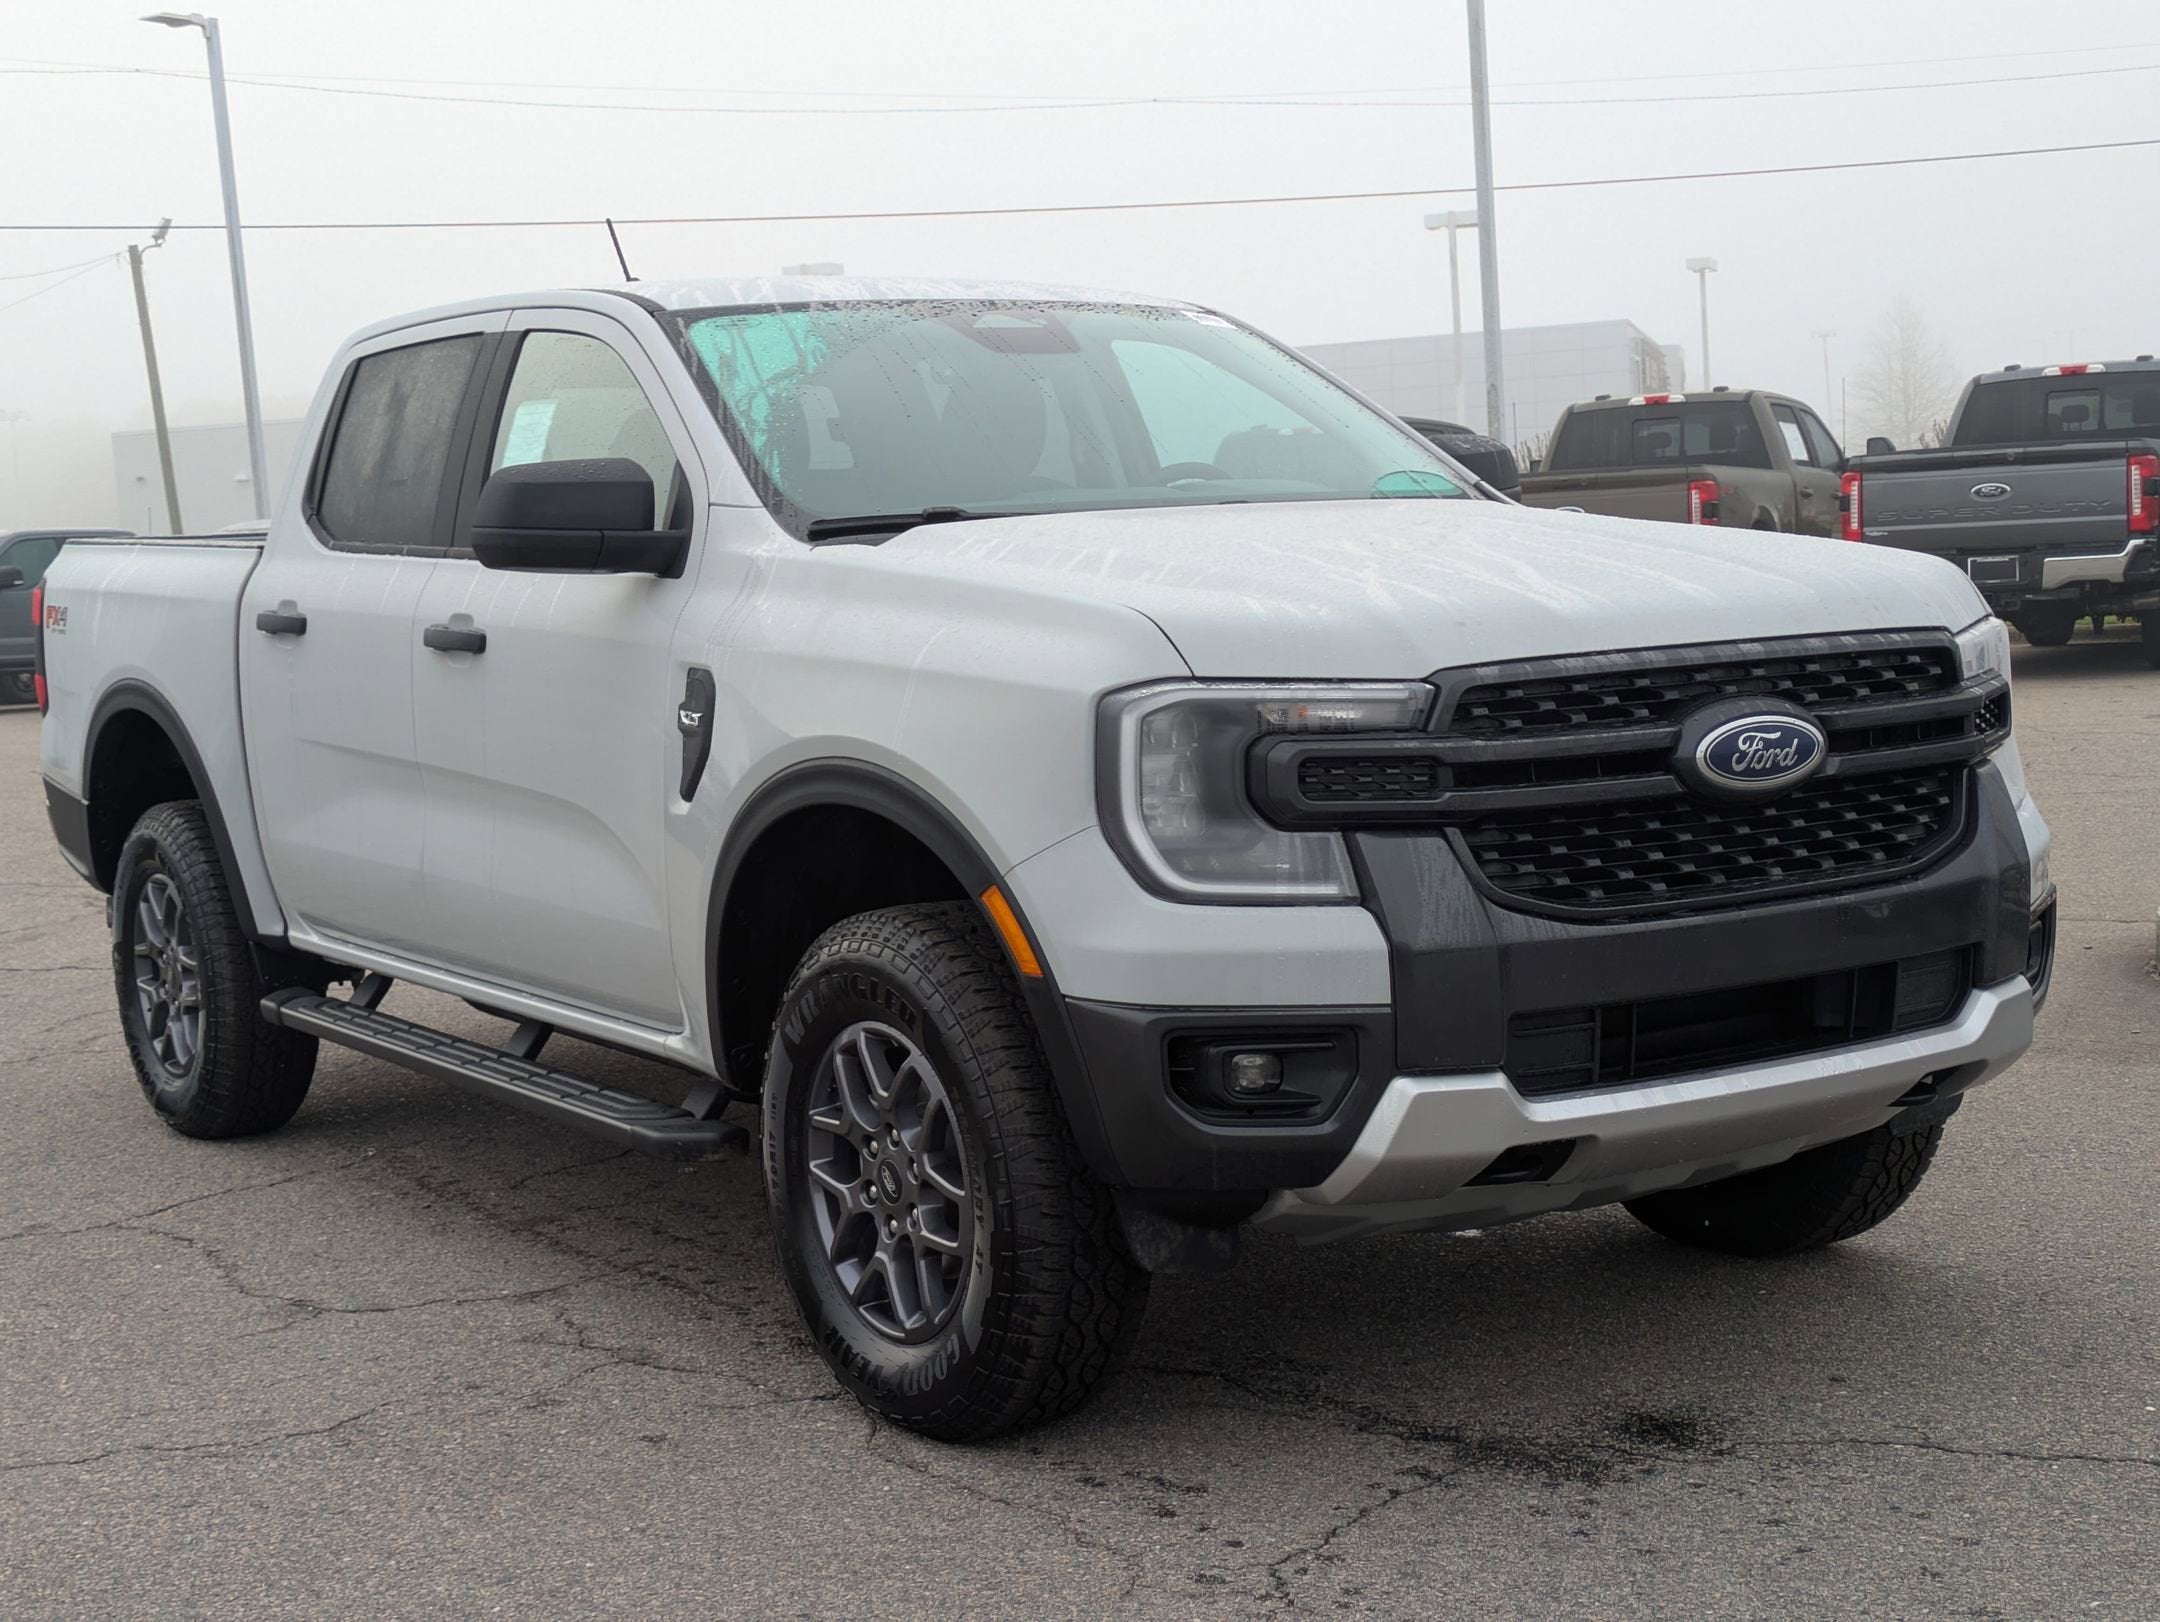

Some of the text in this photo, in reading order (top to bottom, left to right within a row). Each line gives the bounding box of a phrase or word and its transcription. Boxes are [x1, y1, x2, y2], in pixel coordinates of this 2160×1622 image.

[1876, 501, 2111, 521] SUPER DUTY
[1731, 731, 1799, 772] Ford
[784, 972, 917, 1045] WRANGLER
